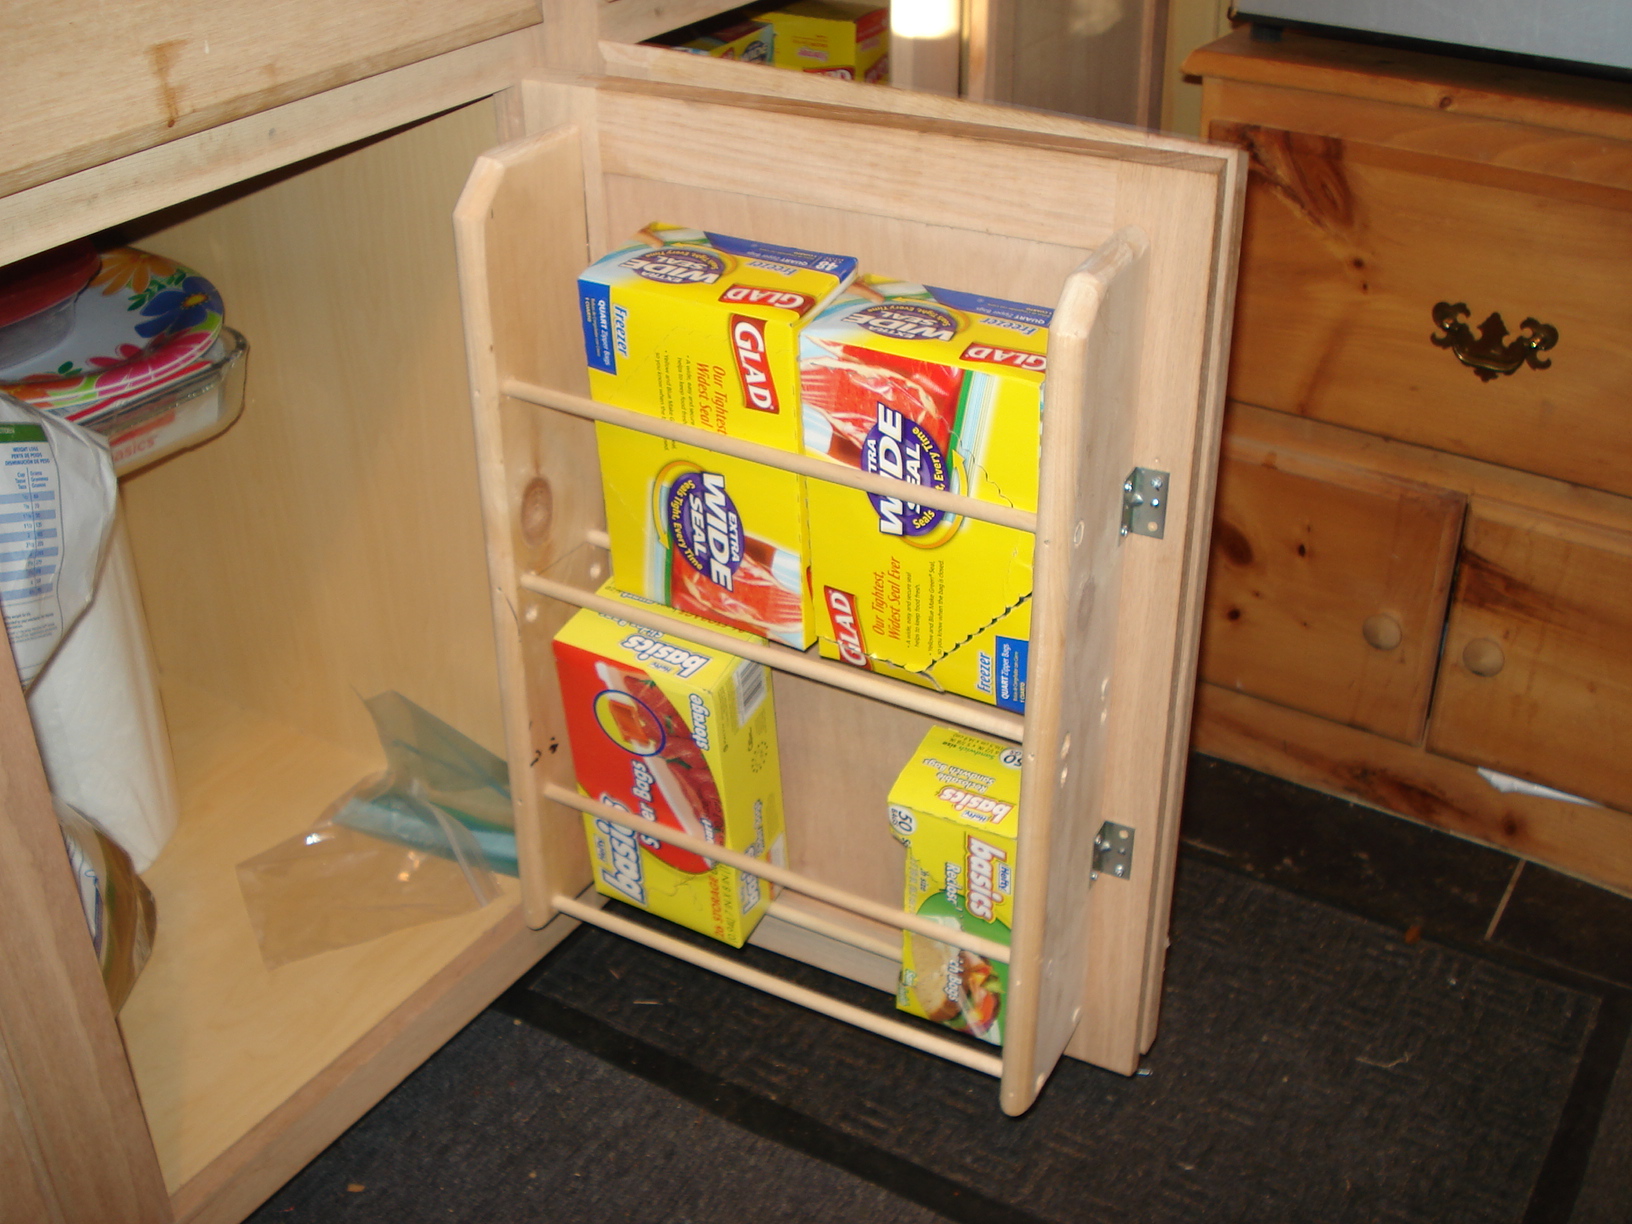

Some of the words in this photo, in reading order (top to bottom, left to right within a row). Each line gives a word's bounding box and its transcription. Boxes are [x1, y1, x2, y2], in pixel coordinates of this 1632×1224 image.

[619, 258, 721, 285] WIDE
[657, 255, 708, 270] SEAL
[748, 260, 797, 275] Freezer
[641, 271, 683, 283] EXTRA
[724, 287, 805, 309] GLAD
[597, 299, 608, 330] QUART
[841, 313, 956, 341] WIDE
[881, 310, 938, 326] SEAL
[980, 318, 1036, 335] Freezer
[614, 305, 628, 357] Freezer
[868, 326, 916, 339] EXTRA
[734, 321, 772, 409] GLAD
[968, 346, 1047, 371] GLAD
[697, 362, 711, 401] Widest
[712, 365, 726, 388] Our
[698, 402, 714, 428] Seal
[912, 427, 933, 453] Time
[930, 452, 945, 482] Every
[676, 479, 696, 499] Seals
[689, 493, 707, 556] SEAL
[702, 472, 734, 592] WIDE
[912, 509, 936, 529] Seals
[673, 522, 687, 549] Every
[727, 511, 740, 562] EXTRA
[684, 549, 704, 571] Time
[888, 556, 901, 580] Ever
[887, 580, 901, 606] Seal
[831, 591, 867, 666] GLAD
[872, 615, 885, 636] Our
[888, 606, 901, 641] Widest
[620, 634, 710, 678] basics
[976, 652, 991, 693] Freezer
[1001, 676, 1010, 699] QUART
[690, 693, 710, 751] storage
[922, 757, 949, 773] Bags
[958, 746, 996, 760] Sandwich
[632, 759, 656, 803] Bags
[936, 772, 988, 794] Reclosable
[949, 765, 996, 787] Sandwich
[938, 786, 1013, 824] basics
[964, 810, 988, 822] Hefty
[898, 809, 913, 833] 50
[968, 834, 1007, 923] basics
[1000, 865, 1009, 893] Hefty
[944, 975, 962, 1003] Bags
